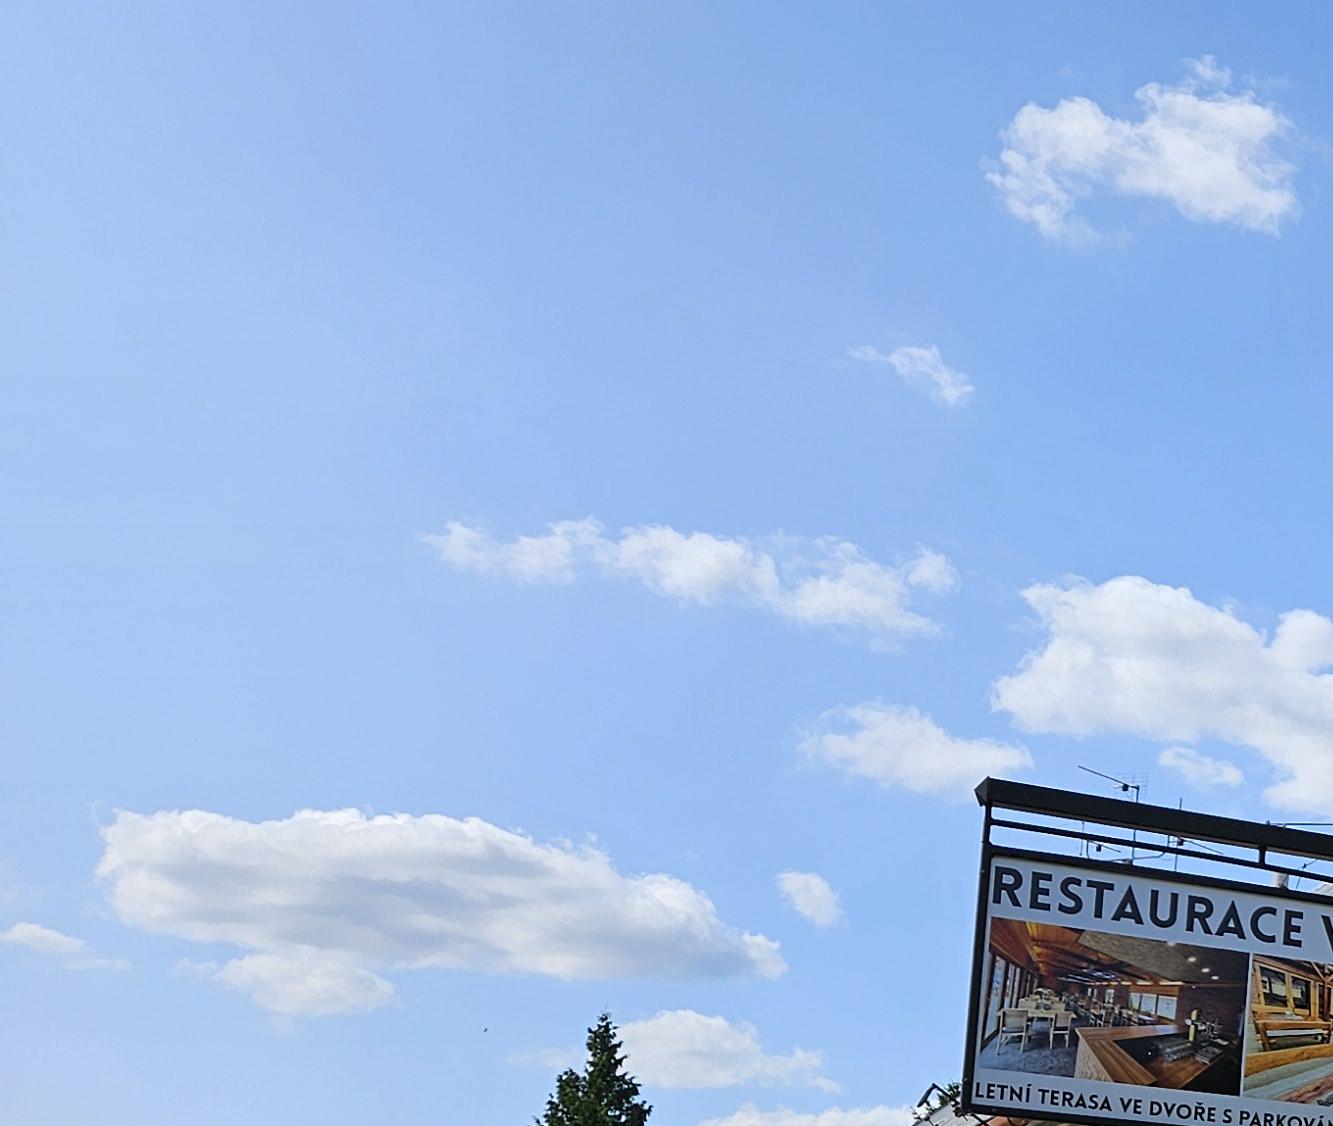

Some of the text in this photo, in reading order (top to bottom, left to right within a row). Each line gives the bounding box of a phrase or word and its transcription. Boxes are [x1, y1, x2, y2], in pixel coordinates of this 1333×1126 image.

[991, 865, 1304, 948] RESTAURACE
[975, 1081, 1032, 1103] LETNÍ
[1038, 1088, 1112, 1112] TERASA
[1119, 1096, 1143, 1115] VE
[1149, 1101, 1217, 1123] DVOŘE
[1222, 1109, 1233, 1124] S
